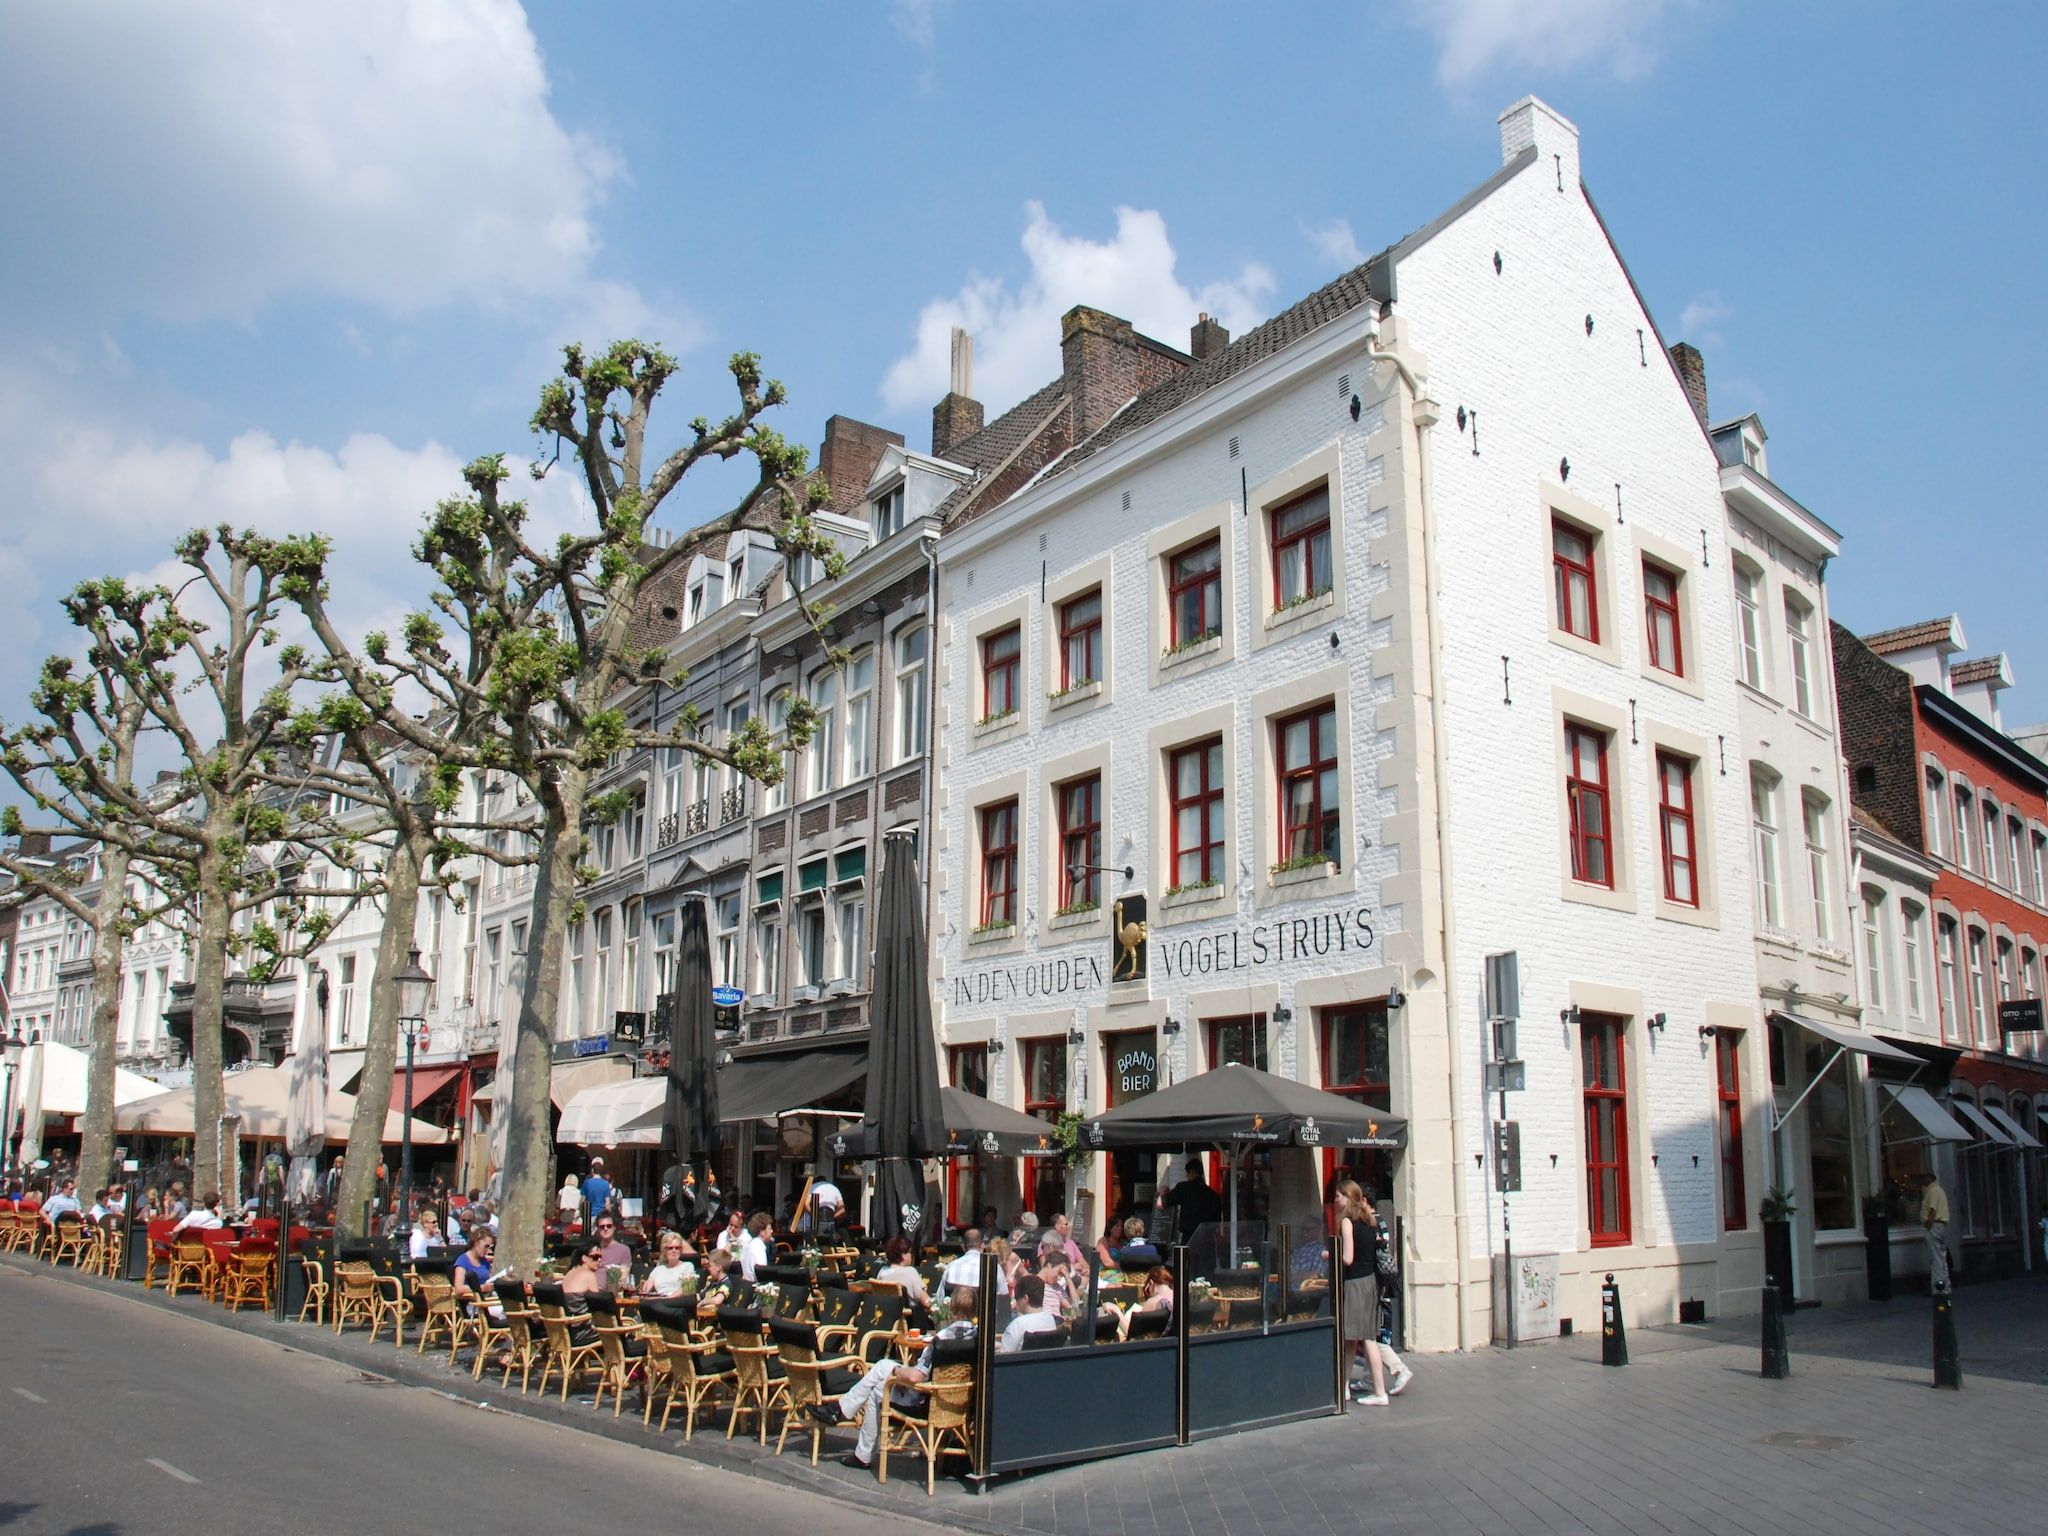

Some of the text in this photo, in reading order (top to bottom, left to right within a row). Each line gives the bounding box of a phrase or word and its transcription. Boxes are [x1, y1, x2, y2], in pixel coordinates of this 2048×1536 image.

[955, 908, 1374, 1006] IN DEN OUDEN VOGELSTRUYS
[712, 991, 741, 1001] Bavaria
[2002, 1010, 2020, 1018] OTTO
[1117, 1051, 1155, 1074] BRAND
[1122, 1075, 1150, 1092] BIER
[1300, 1126, 1321, 1134] ROYAL
[1302, 1133, 1320, 1142] CLUB
